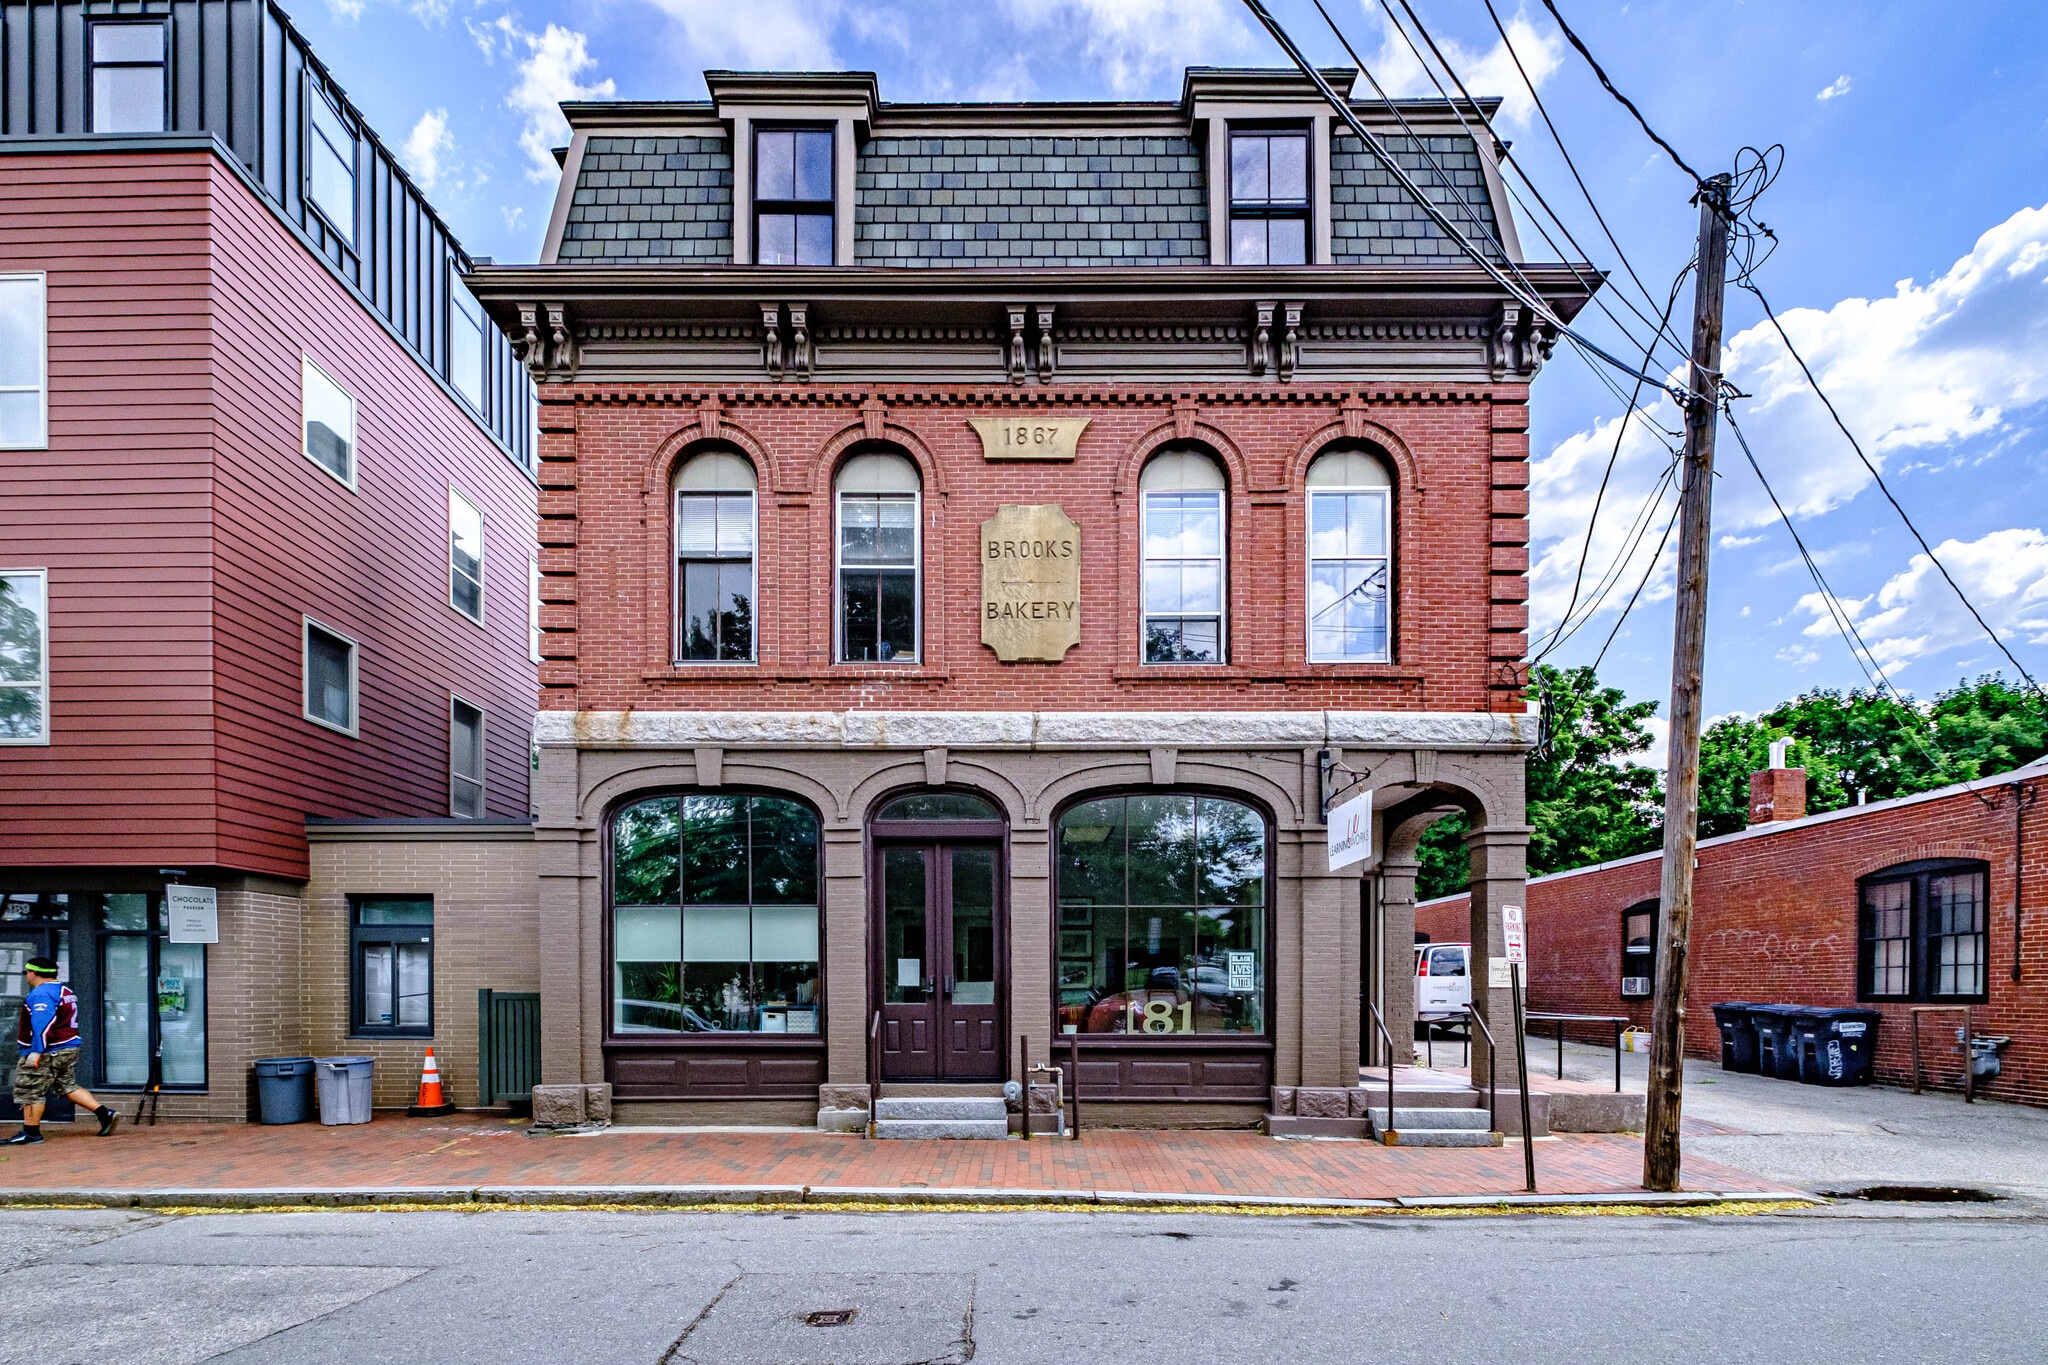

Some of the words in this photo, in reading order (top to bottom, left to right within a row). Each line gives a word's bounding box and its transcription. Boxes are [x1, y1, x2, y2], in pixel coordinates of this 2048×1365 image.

[1003, 427, 1059, 446] 1867
[988, 540, 1074, 559] BROOKS
[986, 601, 1076, 620] BAKERY
[172, 895, 214, 904] CHOCOLATS
[1509, 910, 1517, 921] NO
[1505, 922, 1521, 932] PARKING
[1231, 964, 1251, 975] LIVES
[1231, 977, 1251, 988] MATTER
[1119, 1000, 1196, 1035] 181
